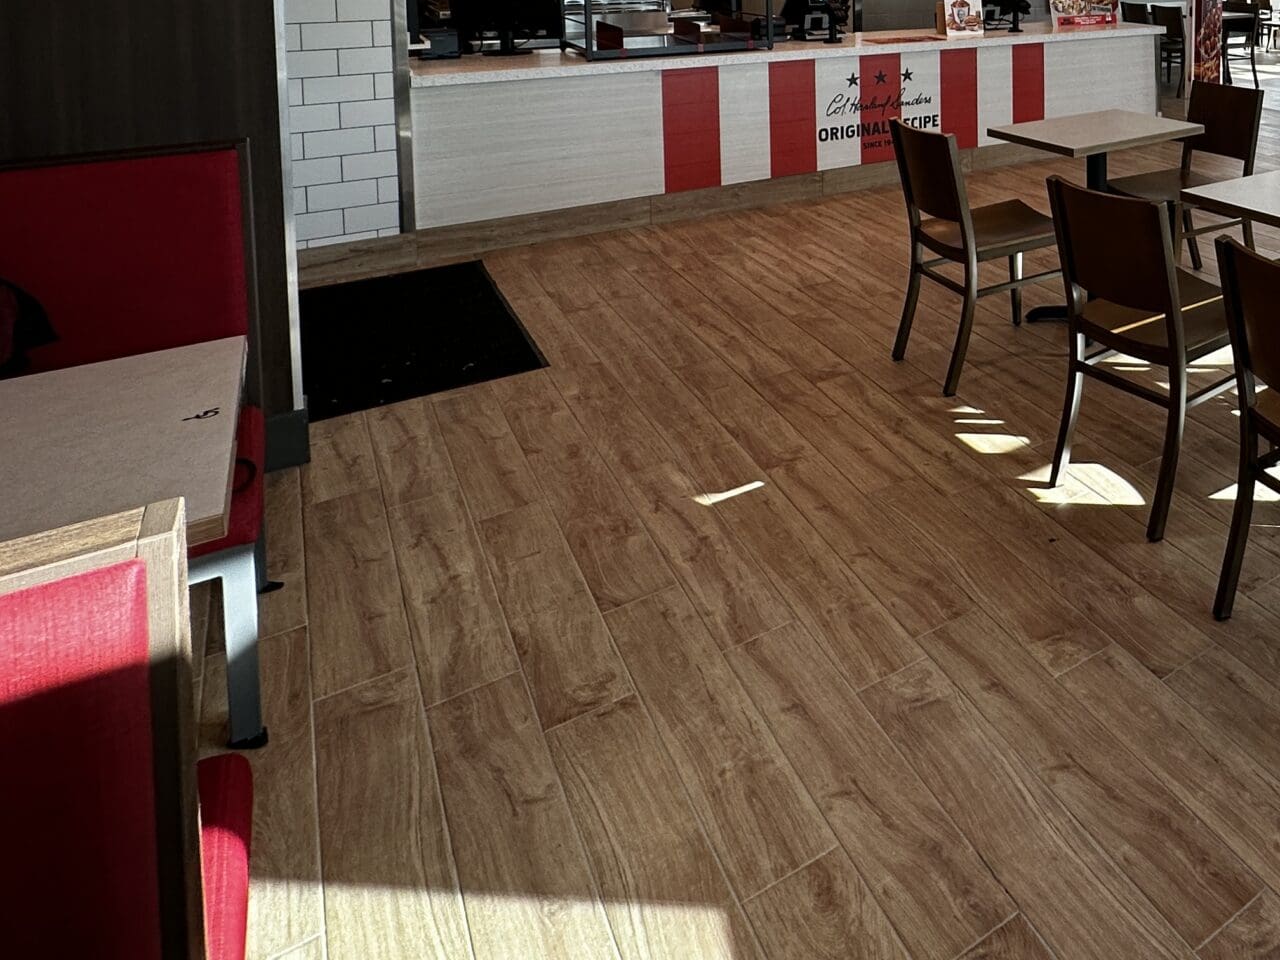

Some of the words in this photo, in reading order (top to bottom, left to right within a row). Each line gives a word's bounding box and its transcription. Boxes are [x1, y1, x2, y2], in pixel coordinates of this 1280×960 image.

[818, 121, 889, 142] ORIGINAL
[903, 114, 940, 130] ECIPE
[863, 140, 883, 150] SINCE
